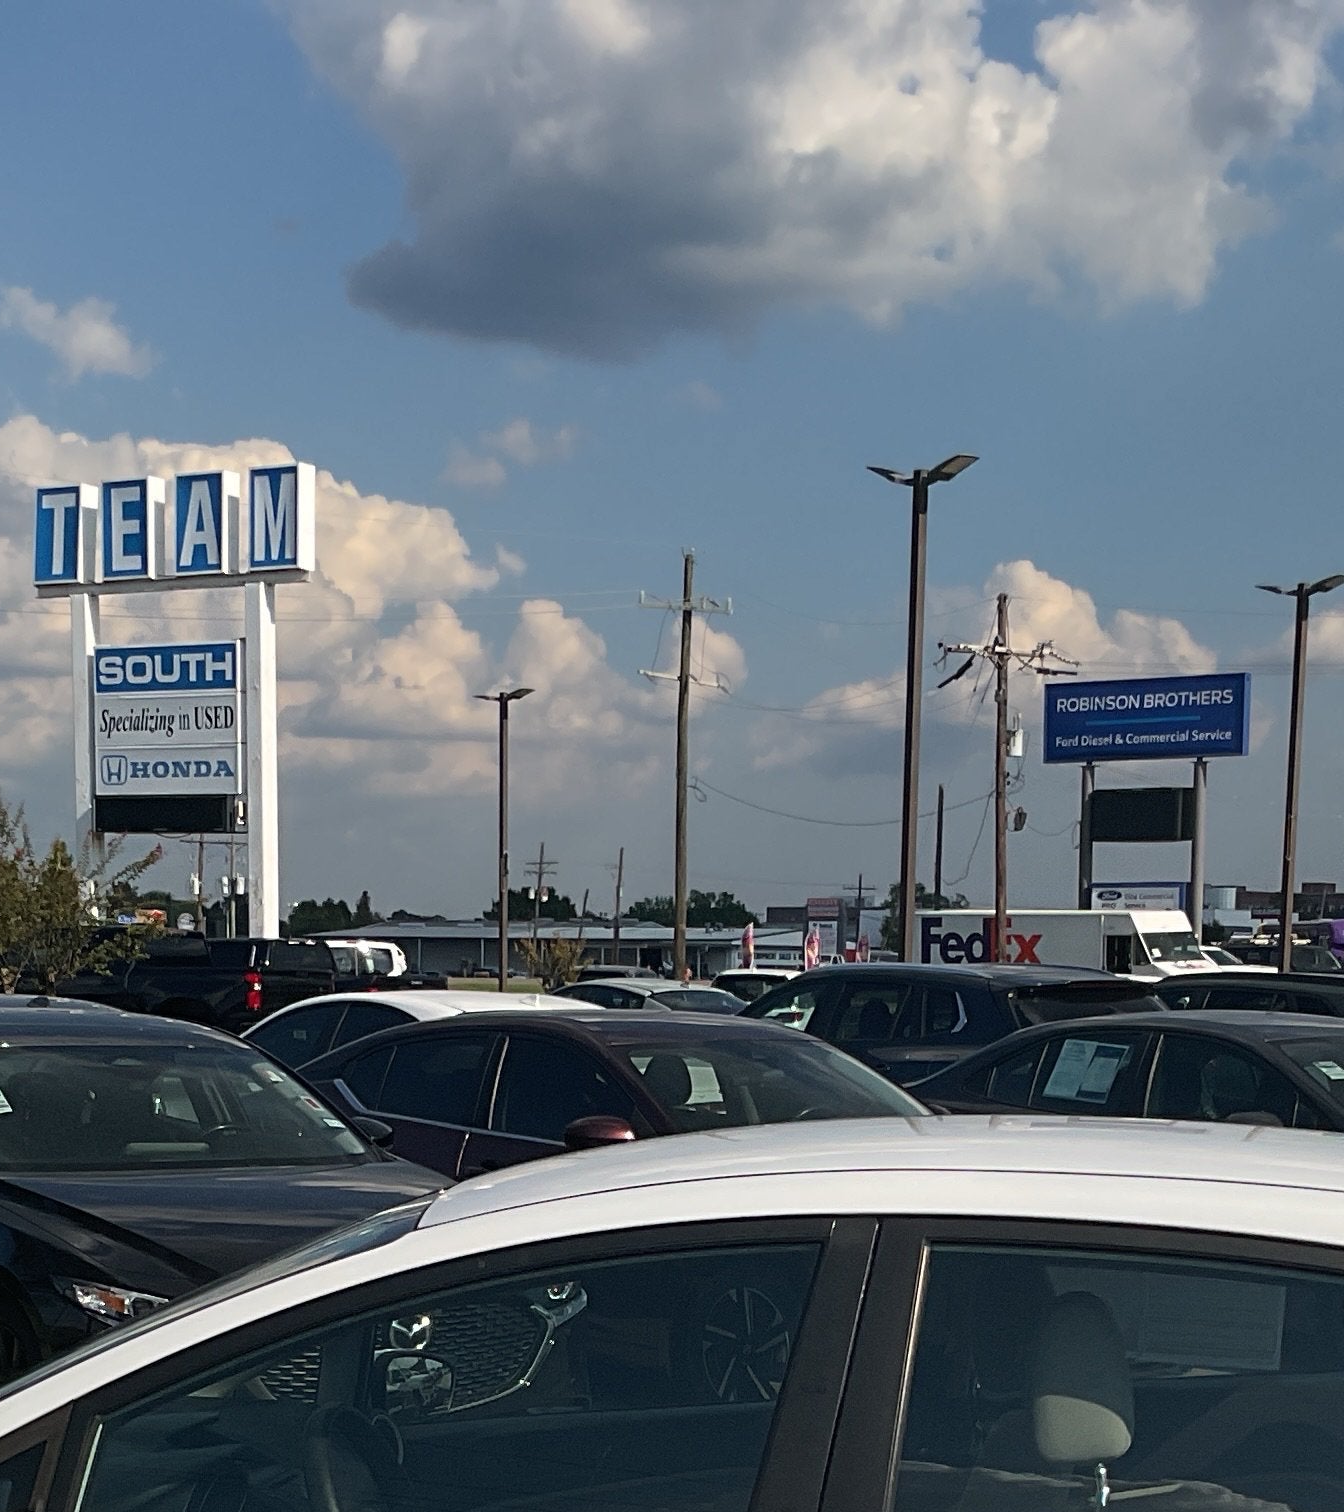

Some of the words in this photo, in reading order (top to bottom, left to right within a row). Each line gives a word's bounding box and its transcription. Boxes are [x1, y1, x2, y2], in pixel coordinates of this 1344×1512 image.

[41, 472, 297, 576] TEAM
[98, 651, 233, 685] SOUTH
[1056, 694, 1141, 713] ROBINSON
[1143, 689, 1234, 709] BROTHERS
[99, 707, 175, 739] Specializing
[178, 706, 191, 731] in
[194, 705, 234, 730] USED
[1055, 736, 1078, 748] Ford
[1081, 734, 1113, 747] Diesel
[1114, 734, 1124, 745] &
[1126, 730, 1189, 745] Commercial
[1191, 729, 1233, 742] Service
[129, 760, 235, 778] HONDA
[921, 917, 1043, 964] FedEx
